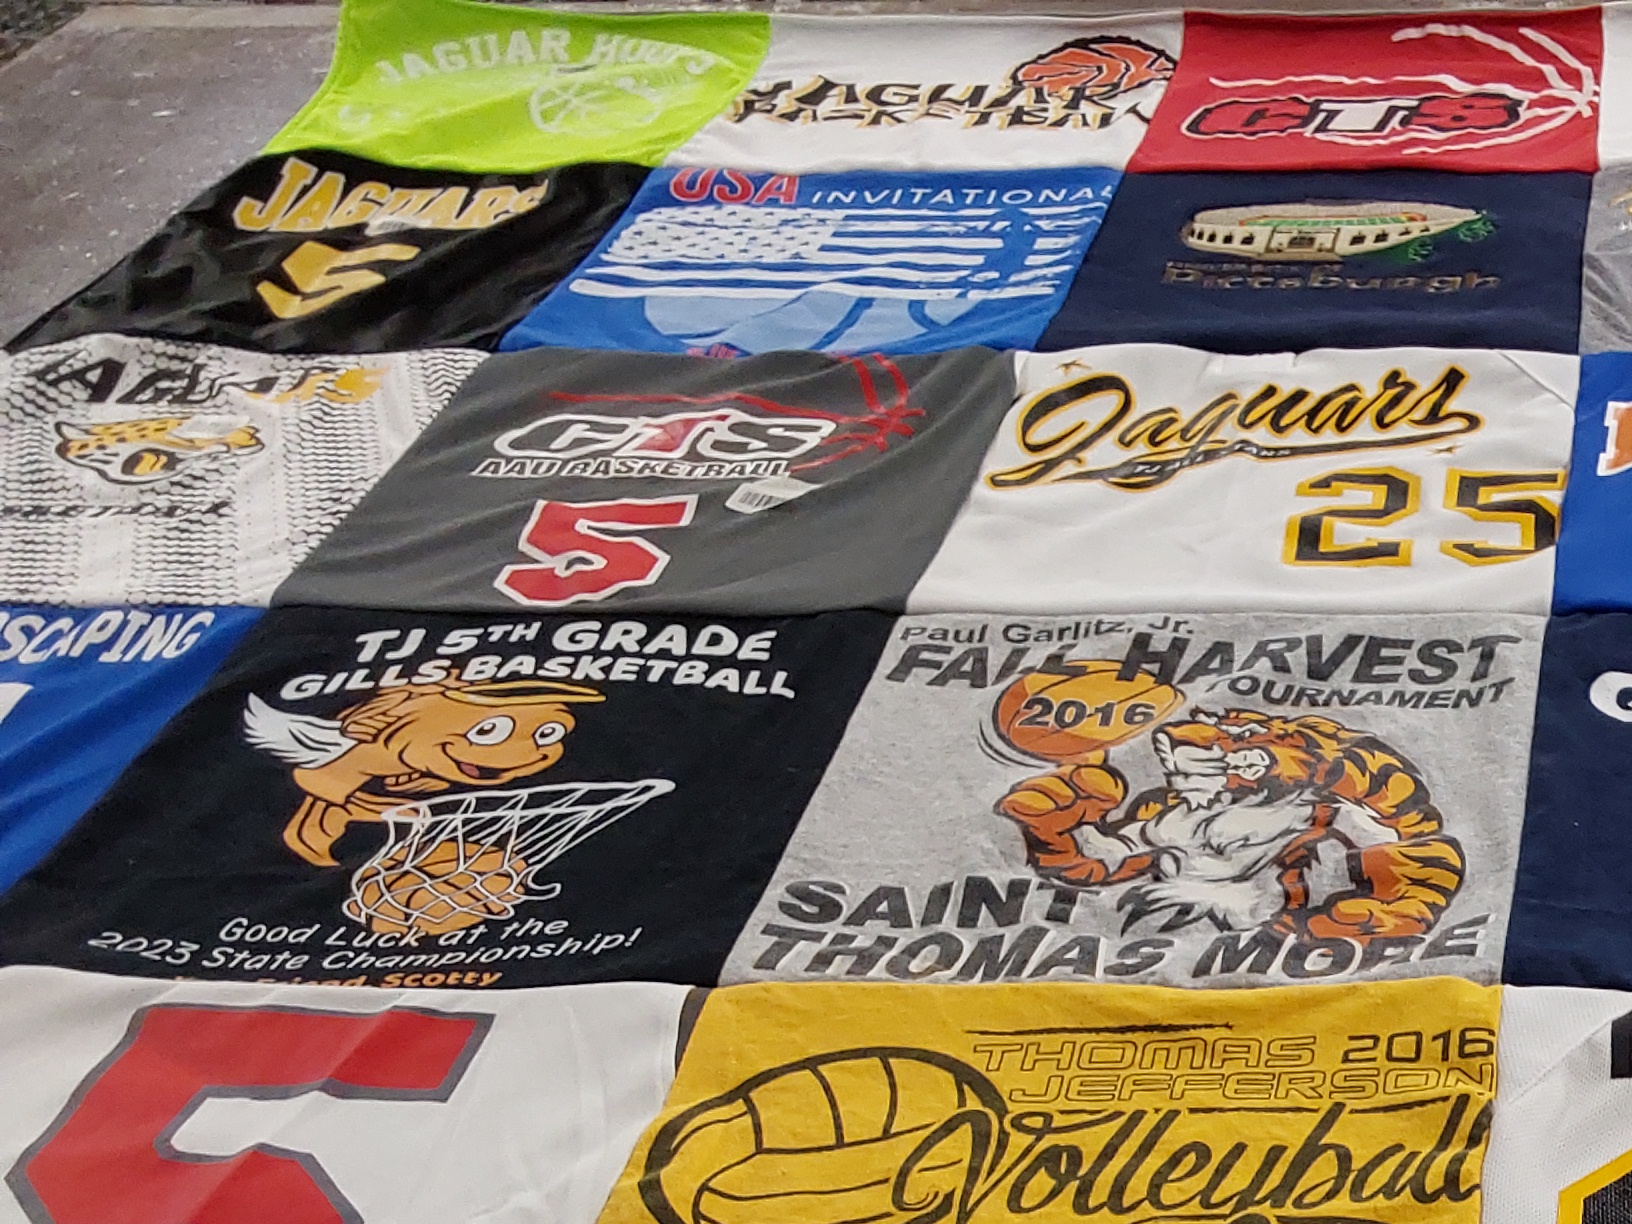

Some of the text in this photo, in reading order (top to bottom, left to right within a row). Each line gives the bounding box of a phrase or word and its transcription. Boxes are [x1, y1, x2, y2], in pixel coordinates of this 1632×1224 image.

[1185, 92, 1524, 138] CTS
[668, 165, 800, 206] USA
[493, 408, 838, 458] CTS
[985, 364, 1485, 491] Jaguars
[470, 456, 792, 480] AAU BASKETBALL
[1281, 465, 1567, 568] 25
[493, 493, 699, 607] 5
[0, 610, 216, 664] SCAPING
[353, 619, 779, 663] TJ 5TH GRADE
[897, 621, 990, 645] Paul
[1146, 614, 1196, 636] Jr.
[280, 652, 797, 700] GILLS BASKETBALL
[884, 632, 1528, 690] FALL HARVEST
[1016, 696, 1157, 731] 2016
[777, 876, 1104, 931] SAINT
[86, 925, 642, 973] 2023 State Championship!
[219, 914, 570, 949] Good Luck at the
[751, 913, 1494, 983] THOMAS MORE
[973, 1026, 1498, 1073] THOMAS 2016
[1008, 1061, 1495, 1104] JEFFERSON
